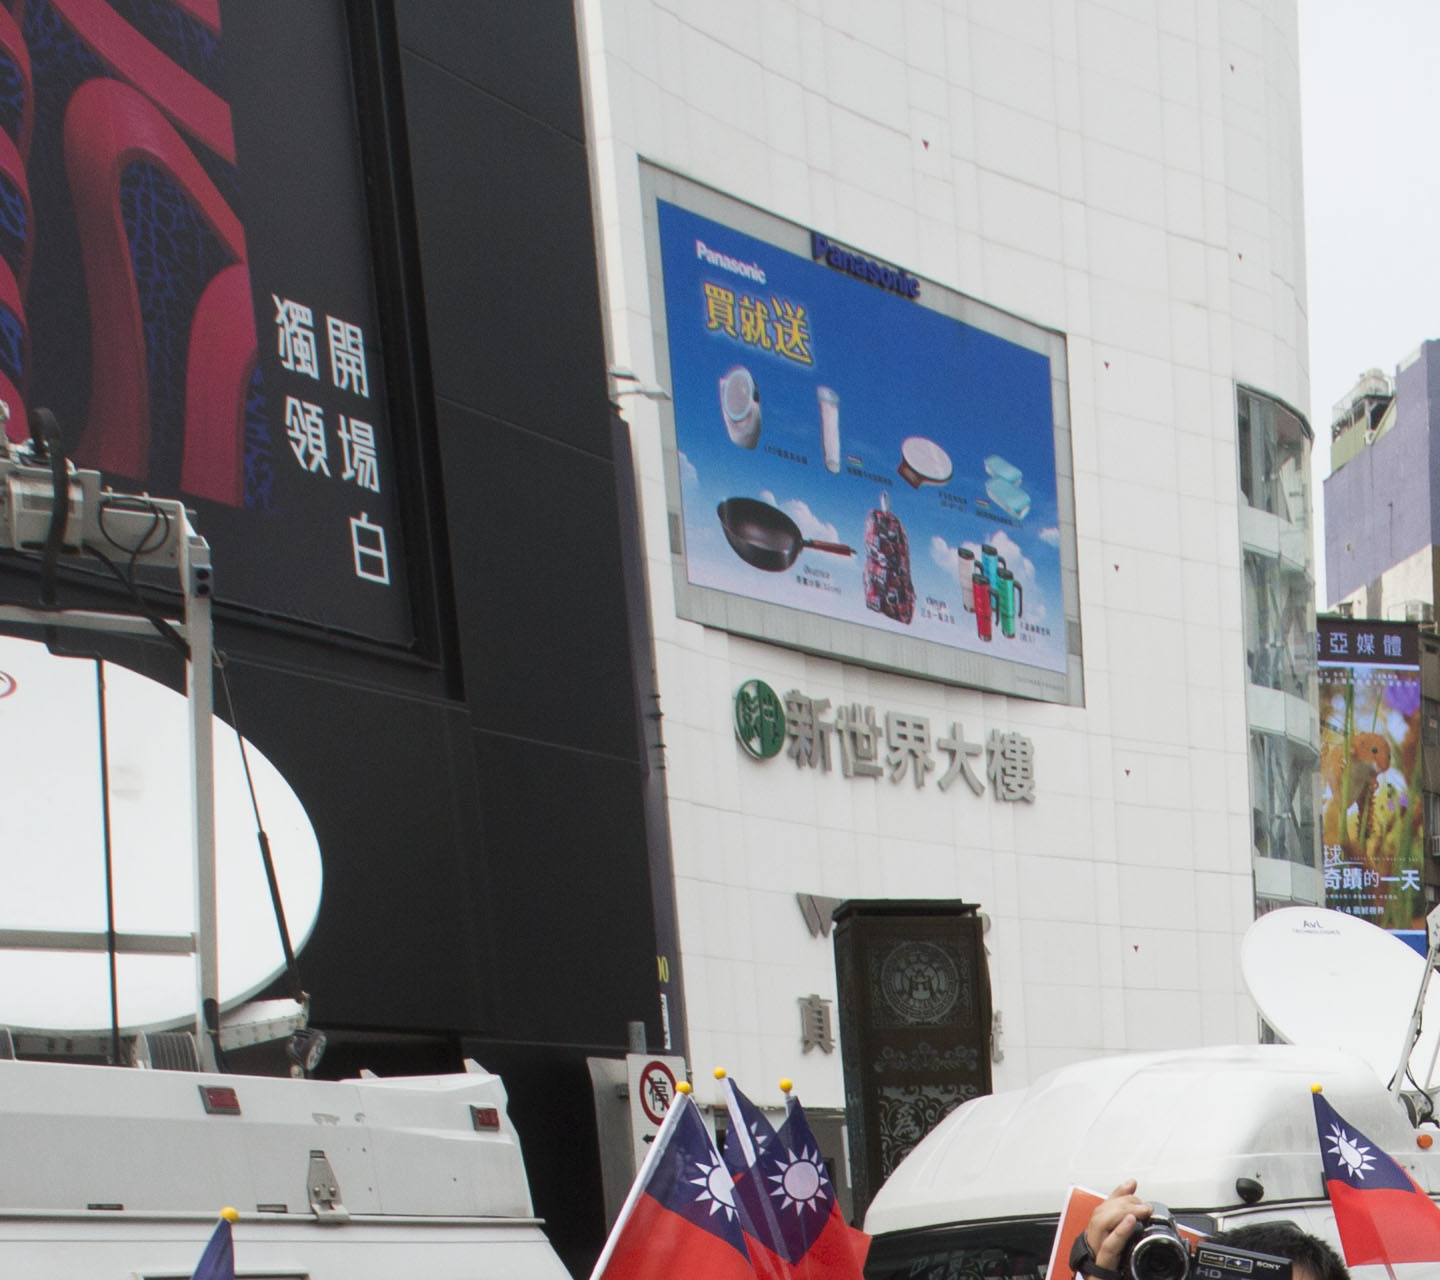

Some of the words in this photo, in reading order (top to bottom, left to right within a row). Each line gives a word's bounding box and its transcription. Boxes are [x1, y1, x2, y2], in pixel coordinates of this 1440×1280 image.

[695, 239, 766, 285] Panasonic
[811, 231, 921, 299] Panasonic
[703, 281, 814, 366] 買就送
[783, 688, 1036, 804] 新世界大樓
[1195, 1267, 1222, 1279] HD
[1256, 1261, 1281, 1271] SONY
